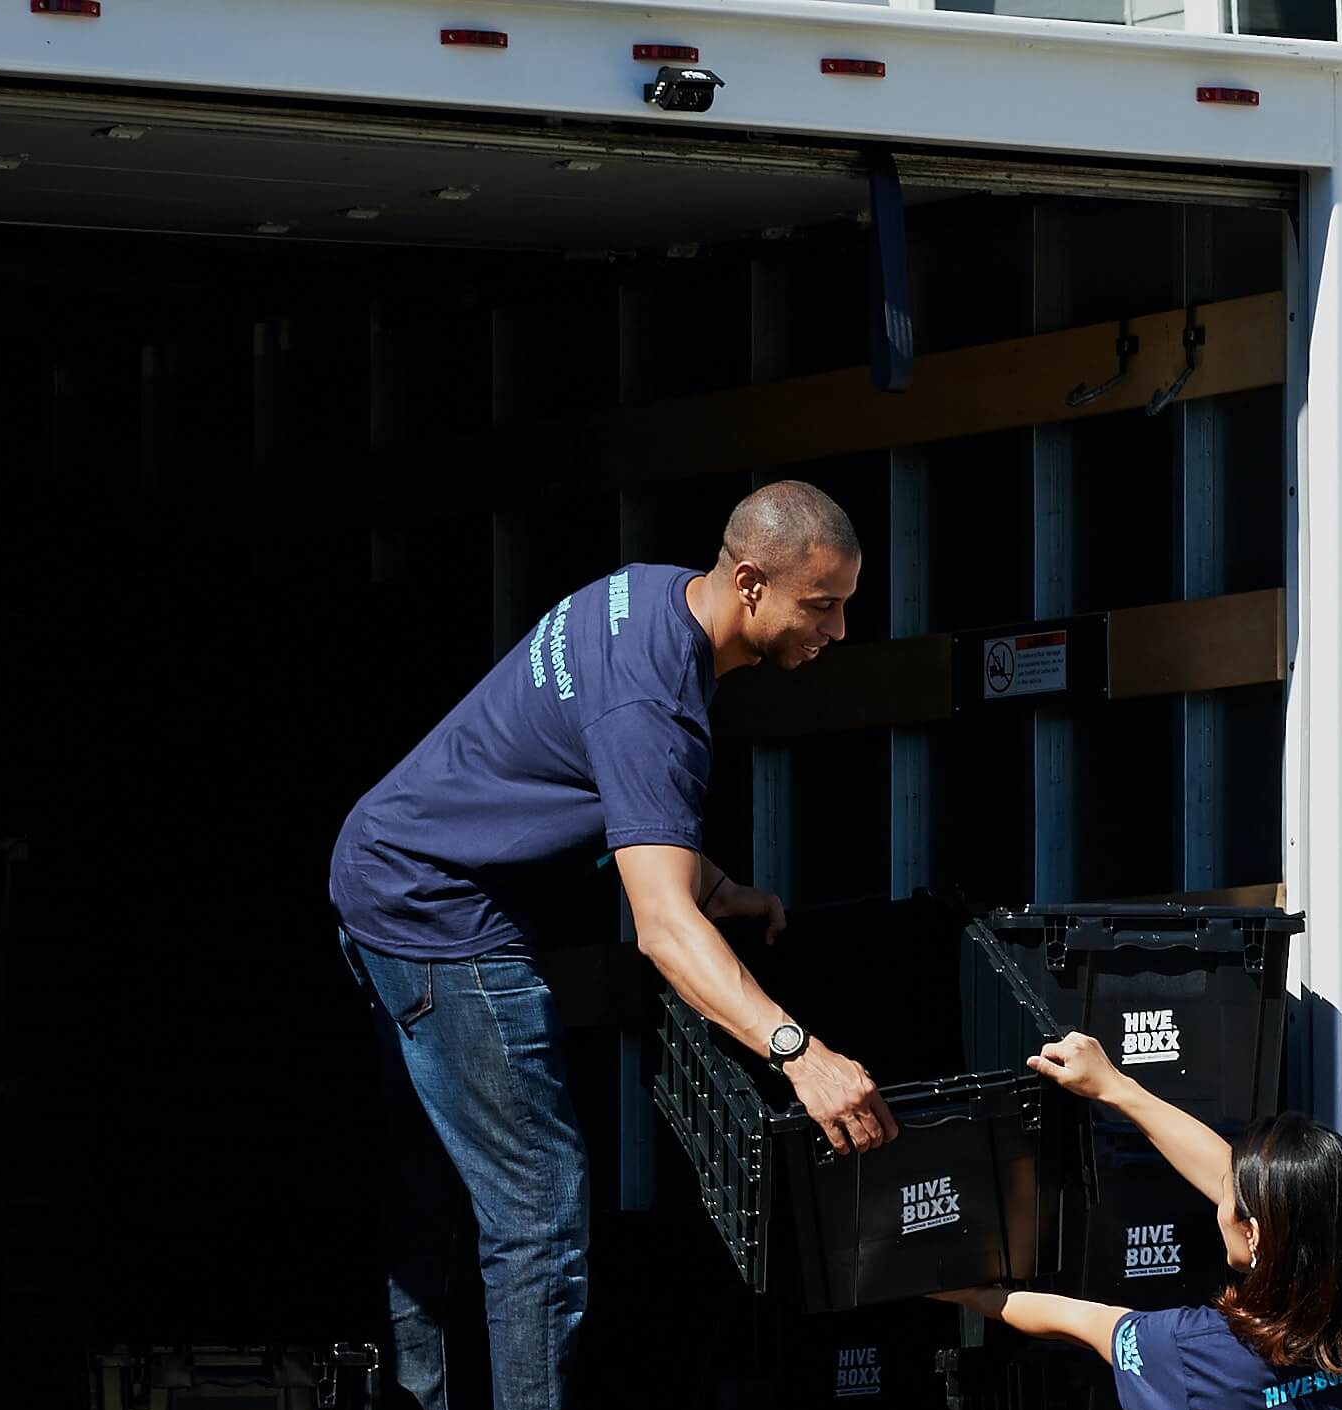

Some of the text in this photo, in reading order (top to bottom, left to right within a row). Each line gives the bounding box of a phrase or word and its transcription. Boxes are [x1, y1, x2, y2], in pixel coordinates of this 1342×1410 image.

[1122, 1010, 1173, 1033] HIVE
[1121, 1030, 1180, 1054] BOXX
[900, 1176, 951, 1204] HIVE
[900, 1194, 960, 1224] BOXX
[1126, 1224, 1174, 1246] HIVE
[1125, 1244, 1181, 1267] BOXX
[838, 1347, 877, 1367] HIVE
[837, 1366, 882, 1386] BOXX
